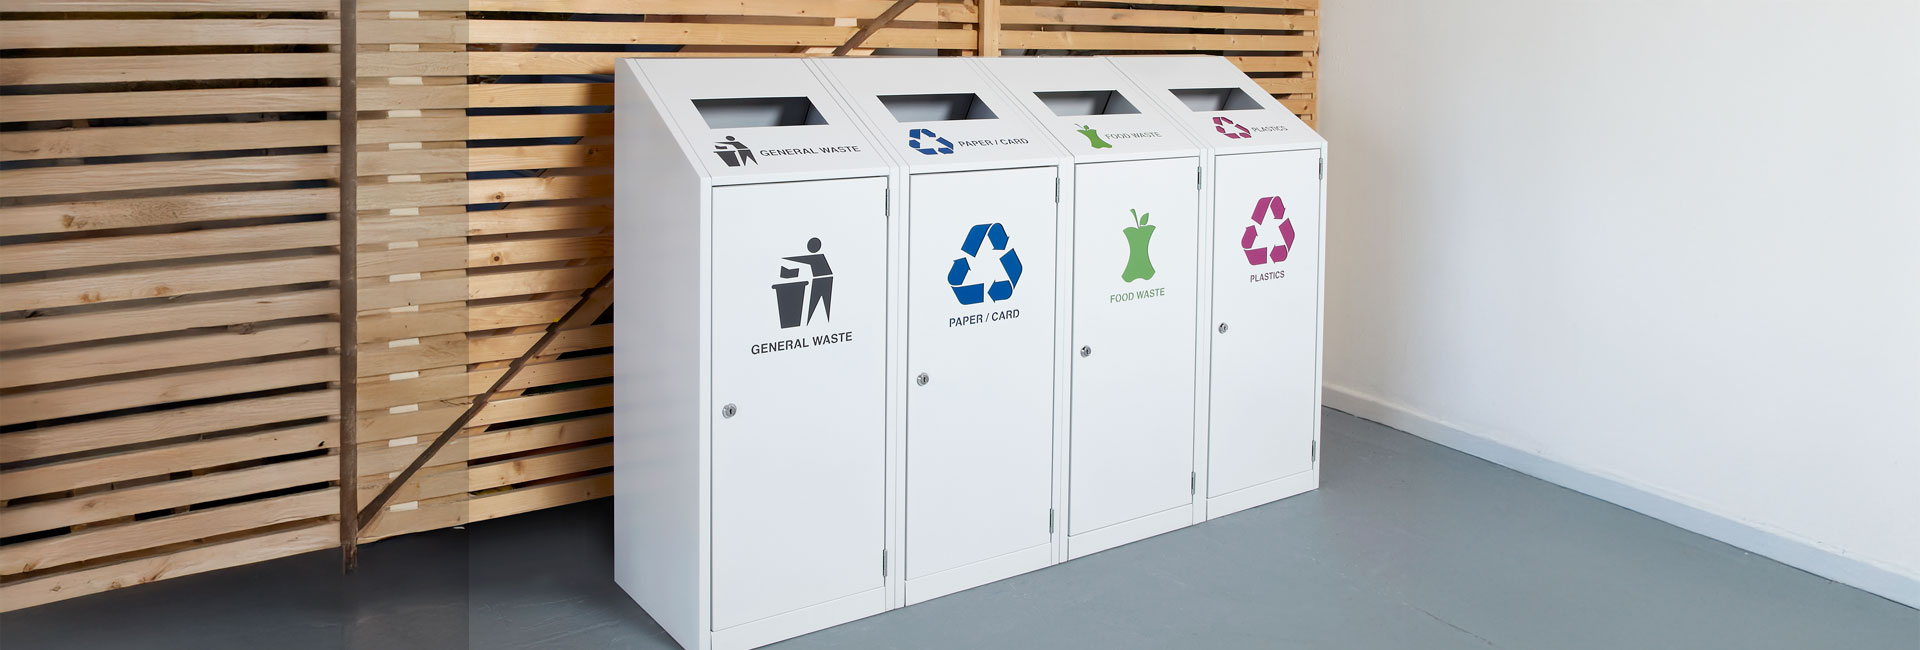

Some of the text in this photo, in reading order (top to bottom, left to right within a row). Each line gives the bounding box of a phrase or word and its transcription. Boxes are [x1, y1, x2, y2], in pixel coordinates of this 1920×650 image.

[1129, 131, 1162, 139] WASTE
[1250, 125, 1289, 133] PLASTICS
[957, 139, 994, 148] PAPER
[999, 137, 1029, 146] CARD
[759, 145, 862, 157] GENERAL WASTE
[1249, 269, 1286, 283] PLASTICS
[1109, 287, 1165, 304] FOOD WASTE
[948, 308, 1020, 328] PAPER / CARD
[750, 331, 853, 356] GENERAL WASTE
